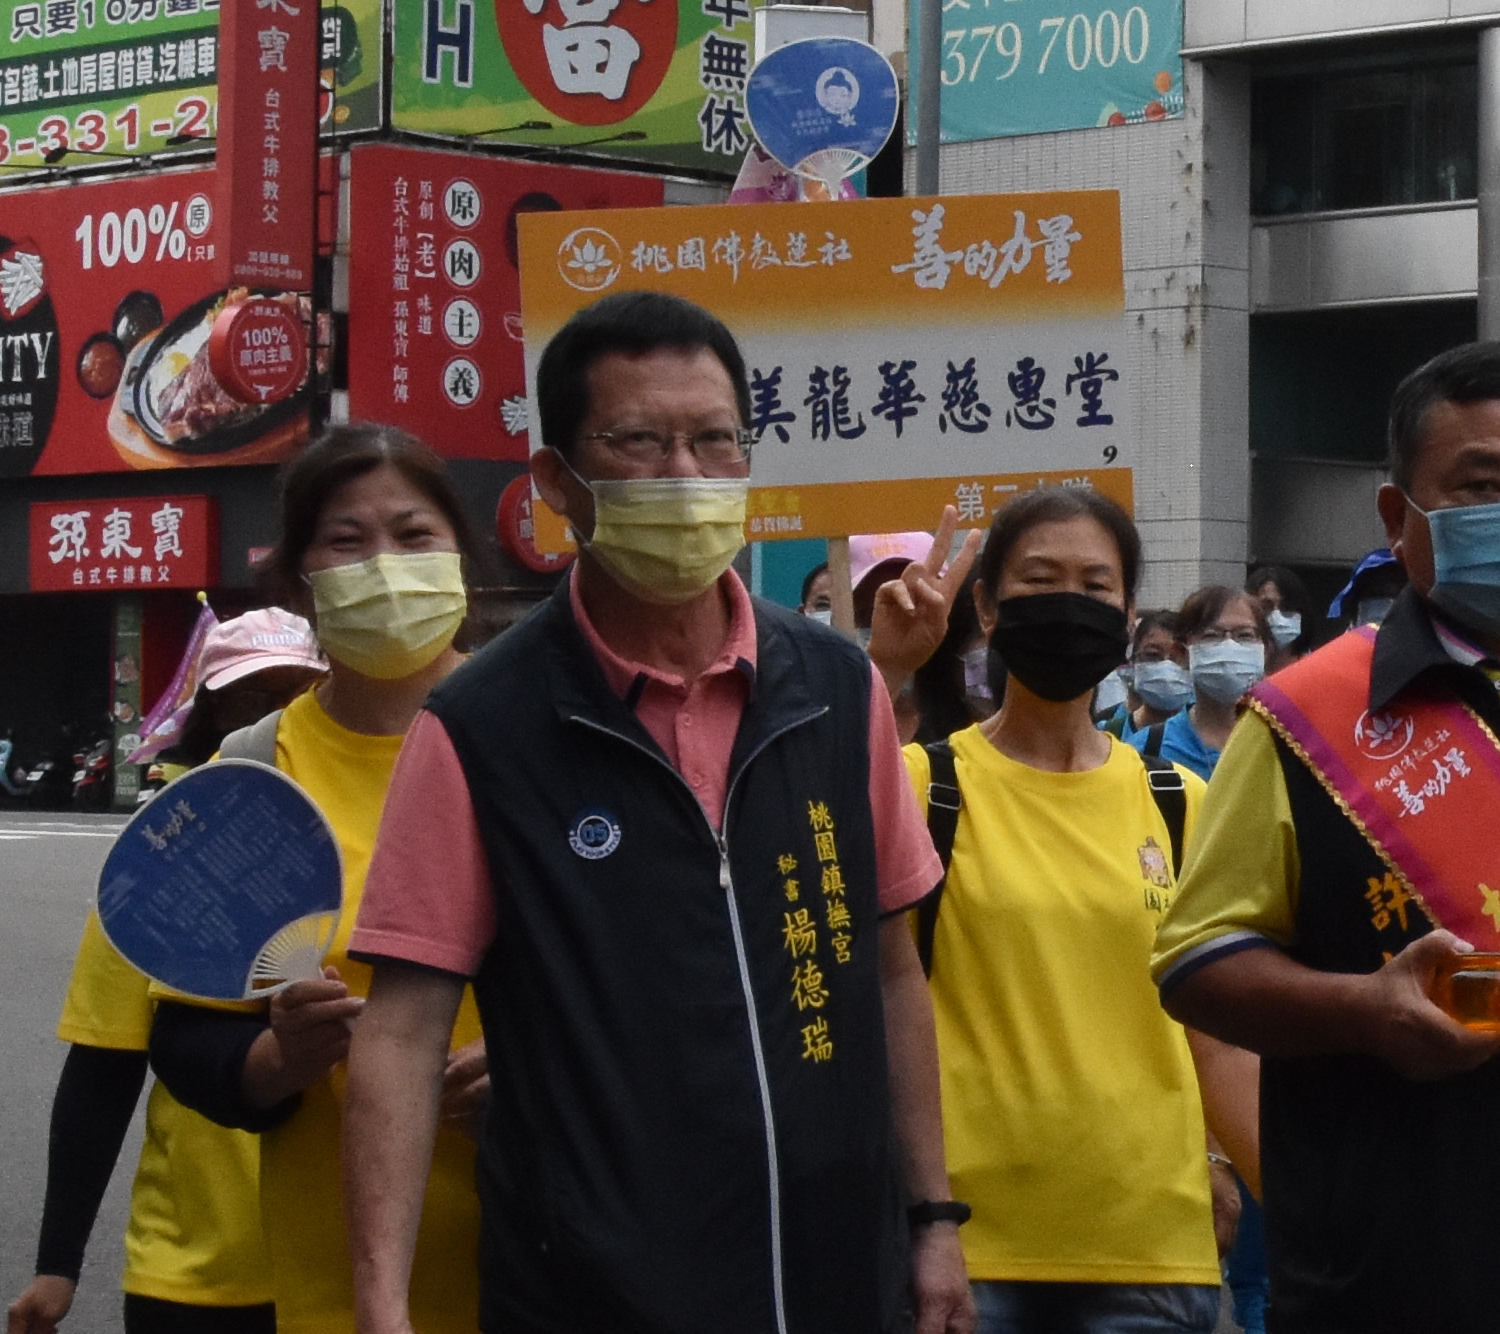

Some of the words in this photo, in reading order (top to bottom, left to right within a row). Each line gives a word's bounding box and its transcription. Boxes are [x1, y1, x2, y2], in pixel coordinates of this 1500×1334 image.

[941, 20, 1023, 86] 379
[1037, 6, 1150, 71] 7000
[262, 88, 280, 224] 台式牛排教父
[76, 201, 187, 270] 100%
[630, 230, 853, 285] 桃園佛教蓮社
[891, 203, 1083, 292] 善的力量
[449, 189, 475, 399] 原肉主義
[242, 325, 289, 346] 100%
[1102, 444, 1119, 466] 9
[49, 502, 183, 564] 孫東寶
[807, 798, 852, 965] 桃園鎮撫宮
[781, 908, 834, 1064] 楊德瑞
